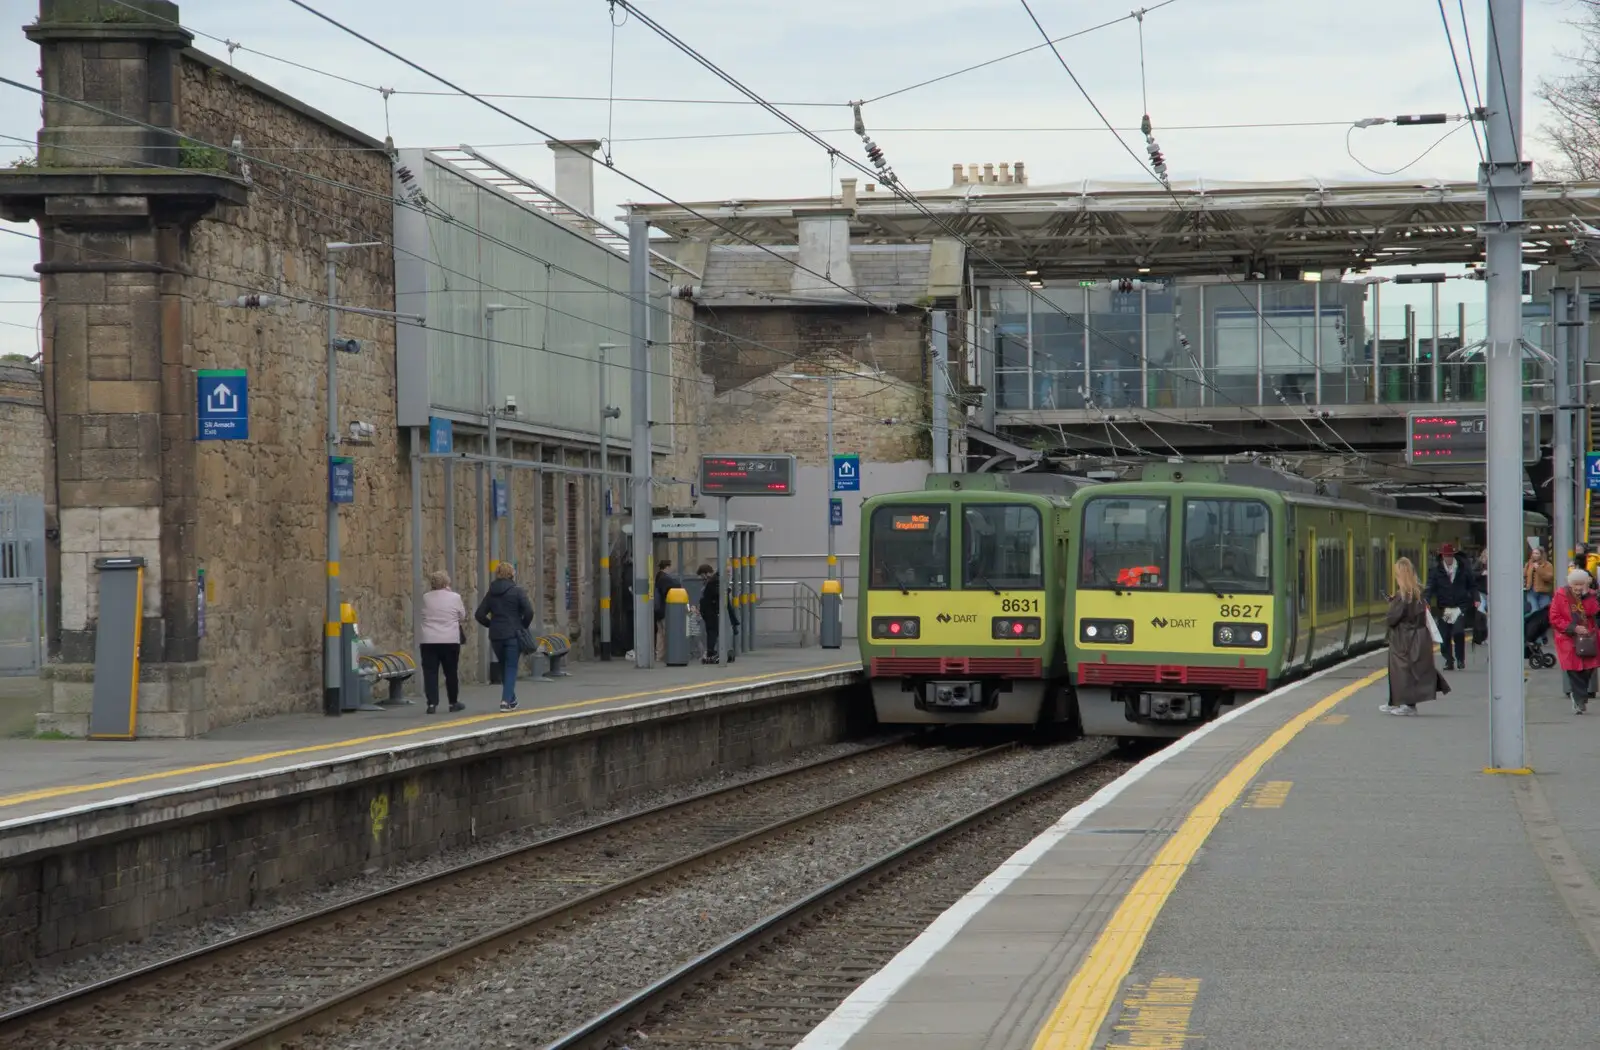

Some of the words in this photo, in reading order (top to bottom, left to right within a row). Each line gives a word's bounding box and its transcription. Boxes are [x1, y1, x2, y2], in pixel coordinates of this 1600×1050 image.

[748, 462, 755, 470] 2
[1002, 599, 1039, 612] 8631
[1220, 604, 1263, 618] 8627
[953, 614, 978, 623] DART
[1170, 619, 1197, 628] DART
